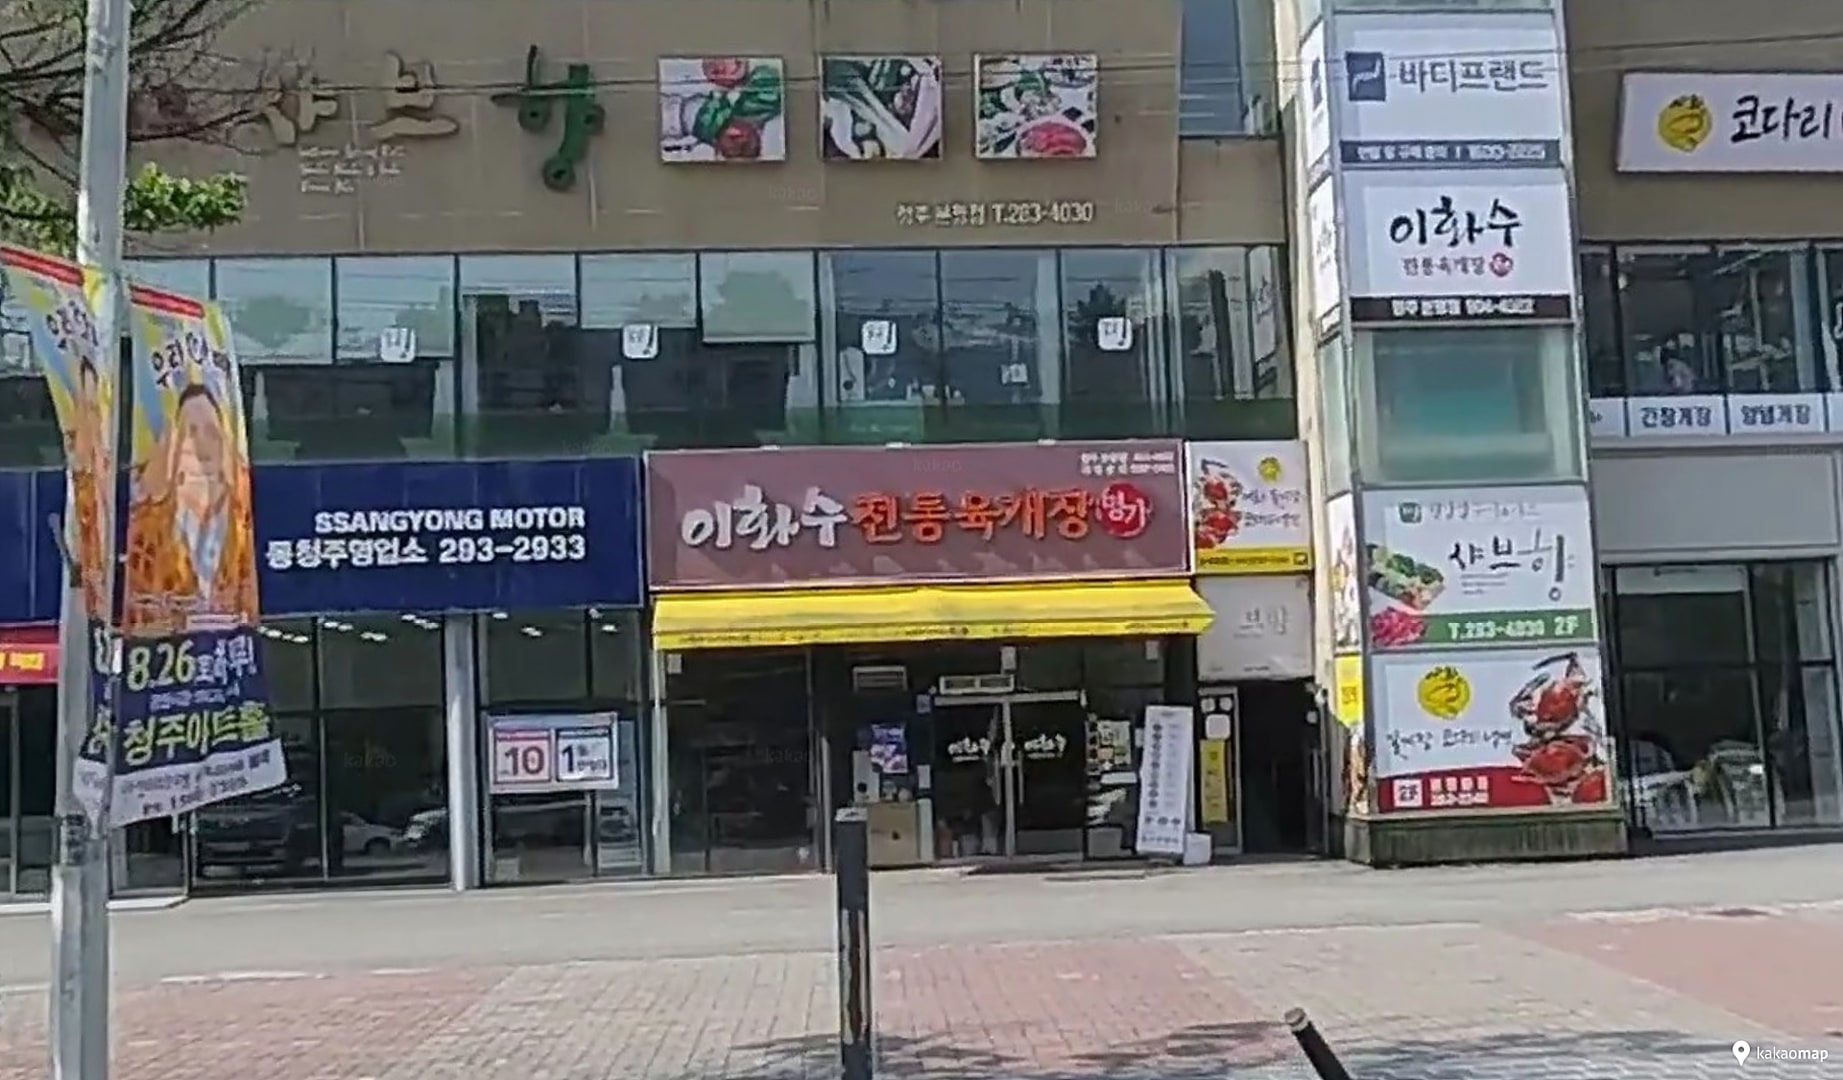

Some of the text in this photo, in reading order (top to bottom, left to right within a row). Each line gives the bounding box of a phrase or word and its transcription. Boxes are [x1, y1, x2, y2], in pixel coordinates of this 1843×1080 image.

[1400, 59, 1549, 93] 바디프랜드
[1731, 94, 1833, 144] 코다리
[1390, 195, 1523, 247] 이화수
[1641, 406, 1712, 429] 간장게장
[1741, 404, 1811, 426] 양념게장
[315, 507, 585, 533] SSANGYONG MOTOR
[681, 484, 848, 549] 이화수
[851, 487, 1093, 543] 전통육개장
[439, 535, 585, 563] 293-2933
[1554, 615, 1579, 636] 2F
[126, 639, 196, 691] 8.26
[505, 746, 545, 776] 10
